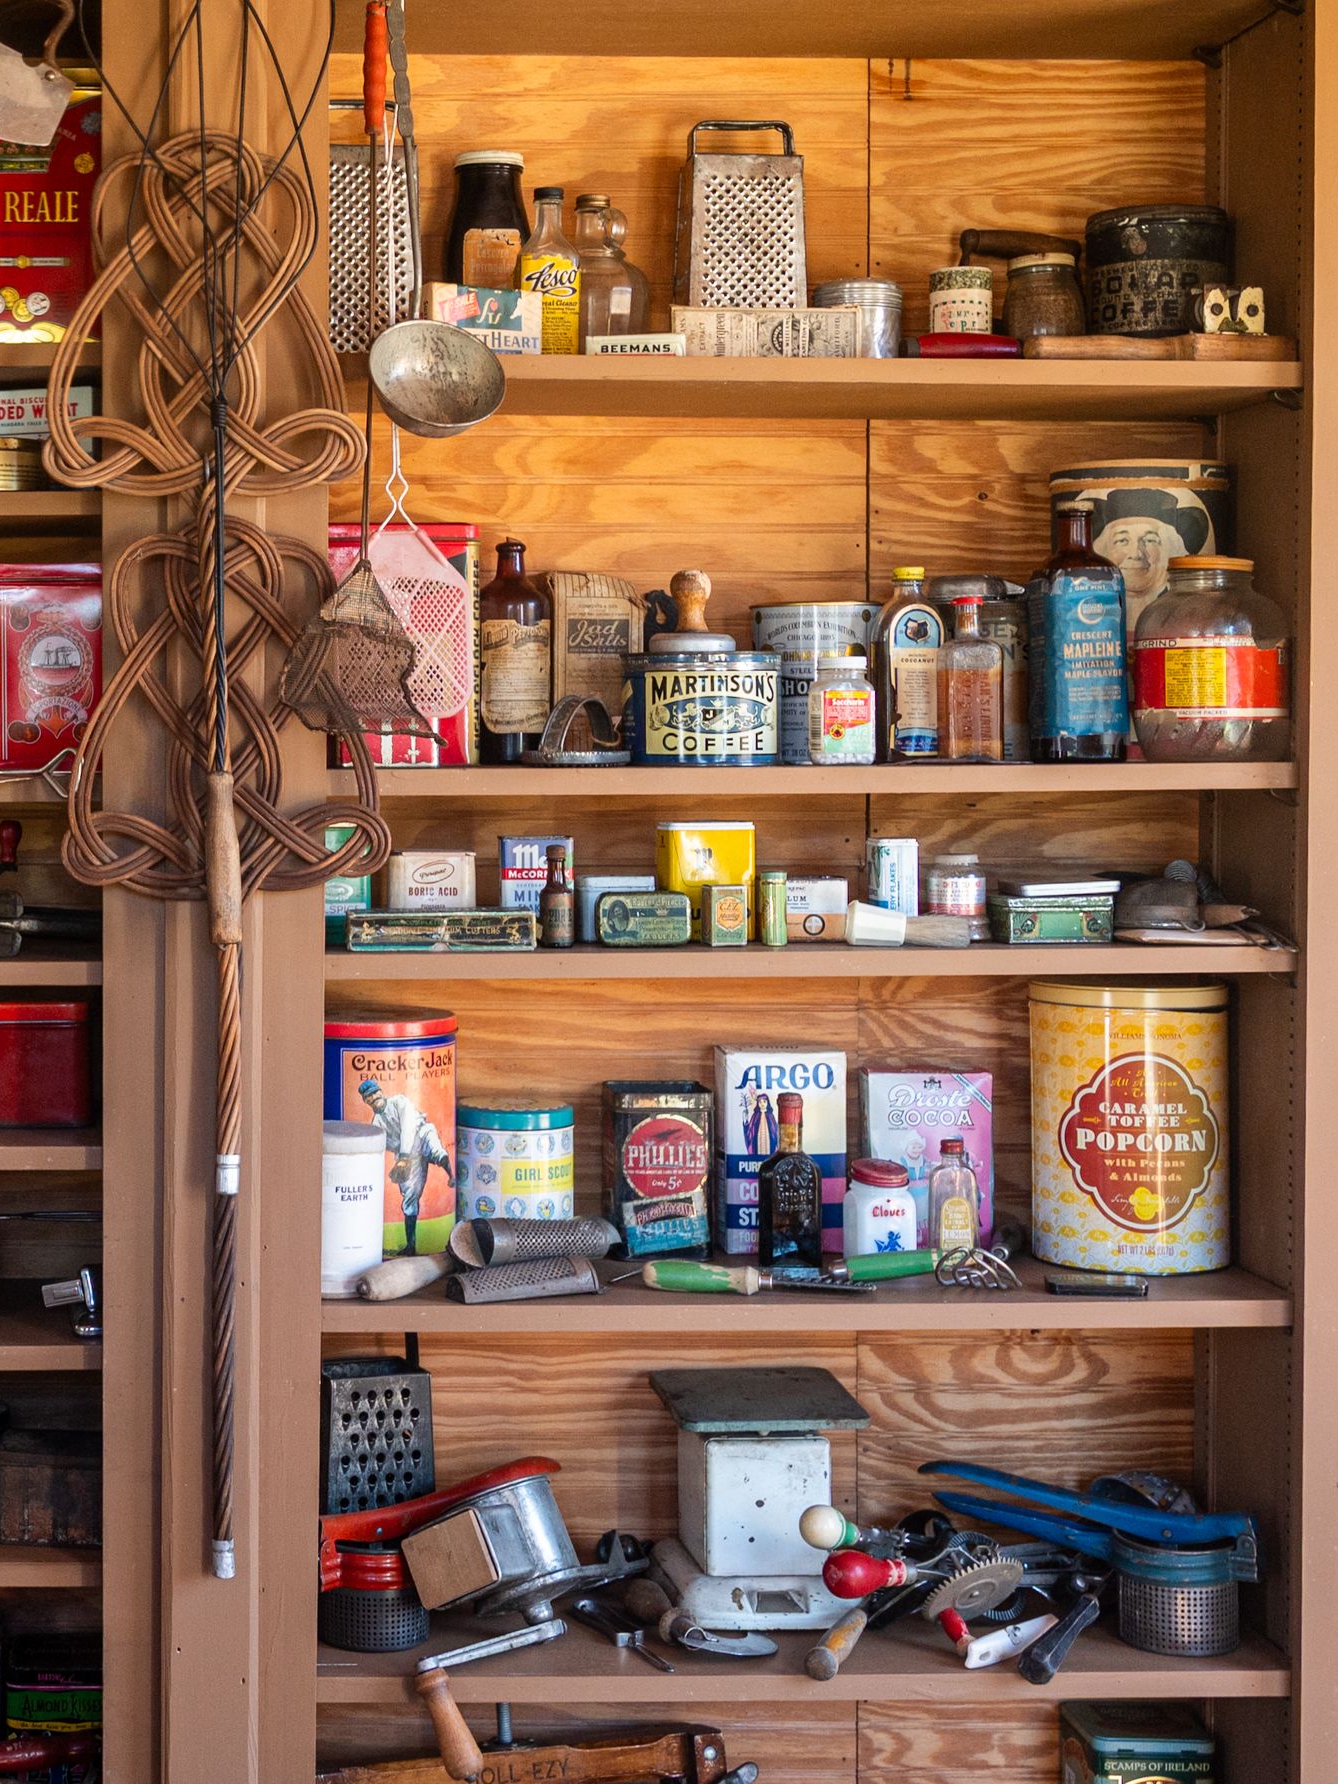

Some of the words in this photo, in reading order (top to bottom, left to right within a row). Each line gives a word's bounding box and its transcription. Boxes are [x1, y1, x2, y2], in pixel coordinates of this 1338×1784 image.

[4, 191, 79, 223] REALE
[600, 343, 671, 354] BEEMANS
[581, 632, 628, 648] Salts
[1071, 631, 1112, 640] CRESCENT
[1064, 641, 1122, 658] MAPLEINE
[1142, 640, 1177, 648] GRIND
[1072, 660, 1115, 669] IMITATION
[1065, 670, 1090, 679] MAPLE
[651, 672, 775, 704] MARTINSON'S
[662, 732, 764, 752] COFFEE
[408, 886, 435, 896] BORIC
[438, 886, 458, 896] ACID
[352, 1053, 425, 1072] Cracker
[425, 1050, 453, 1069] Jack
[360, 1073, 395, 1082] BALL
[406, 1068, 450, 1080] PLAYERS
[736, 1063, 834, 1090] ARGO
[888, 1083, 973, 1108] Droste
[1098, 1102, 1187, 1115] CARAMEL
[888, 1108, 975, 1127] COCOA
[1108, 1115, 1180, 1128] TOFFEE
[1076, 1127, 1207, 1152] POPCORN
[627, 1141, 707, 1168] PHILLIES
[1104, 1158, 1136, 1167] with
[1140, 1158, 1186, 1168] Pecans
[515, 1168, 542, 1181] GIRL
[1123, 1172, 1183, 1182] Almonds
[340, 1193, 368, 1202] EARTH
[872, 1206, 906, 1218] Cloves
[532, 1757, 571, 1781] EZY
[1104, 1761, 1147, 1771] STAMPS
[1149, 1761, 1162, 1771] OF
[1165, 1761, 1210, 1771] IRELAND
